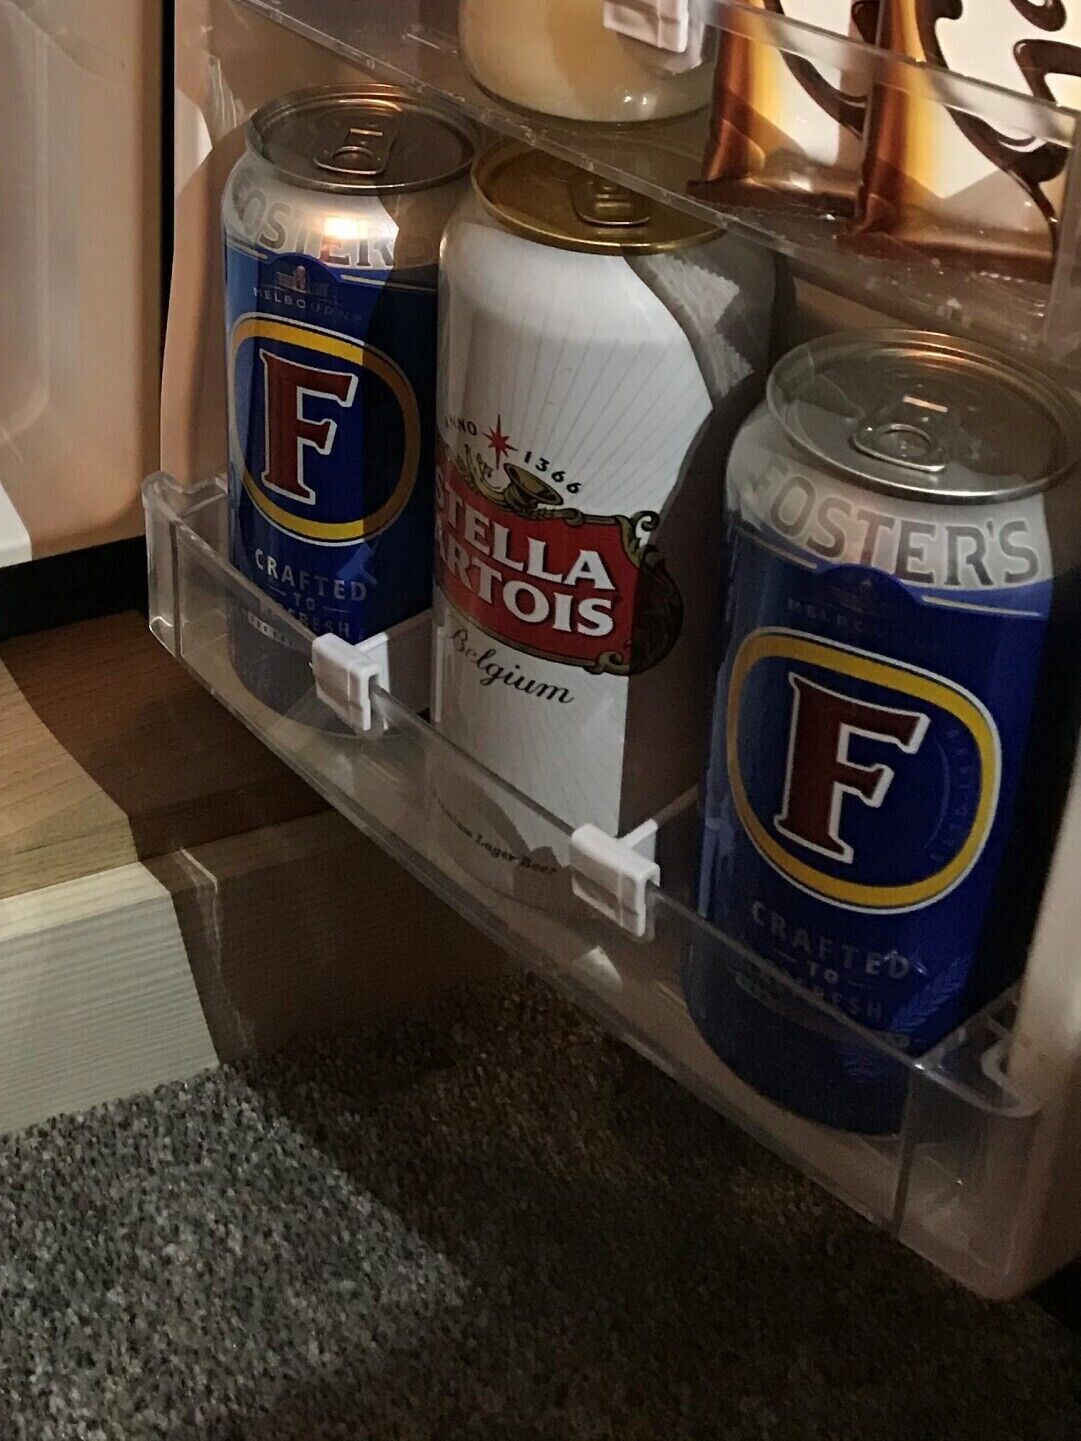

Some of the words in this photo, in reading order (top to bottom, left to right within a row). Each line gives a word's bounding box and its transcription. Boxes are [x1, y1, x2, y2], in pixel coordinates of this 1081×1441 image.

[259, 348, 358, 506] F
[523, 450, 581, 494] 1366
[254, 547, 368, 602] CRAFTED
[293, 592, 316, 613] TO
[450, 628, 574, 704] Belgium
[773, 671, 931, 864] F
[752, 900, 910, 980] CRAFTED
[808, 959, 840, 985] TO
